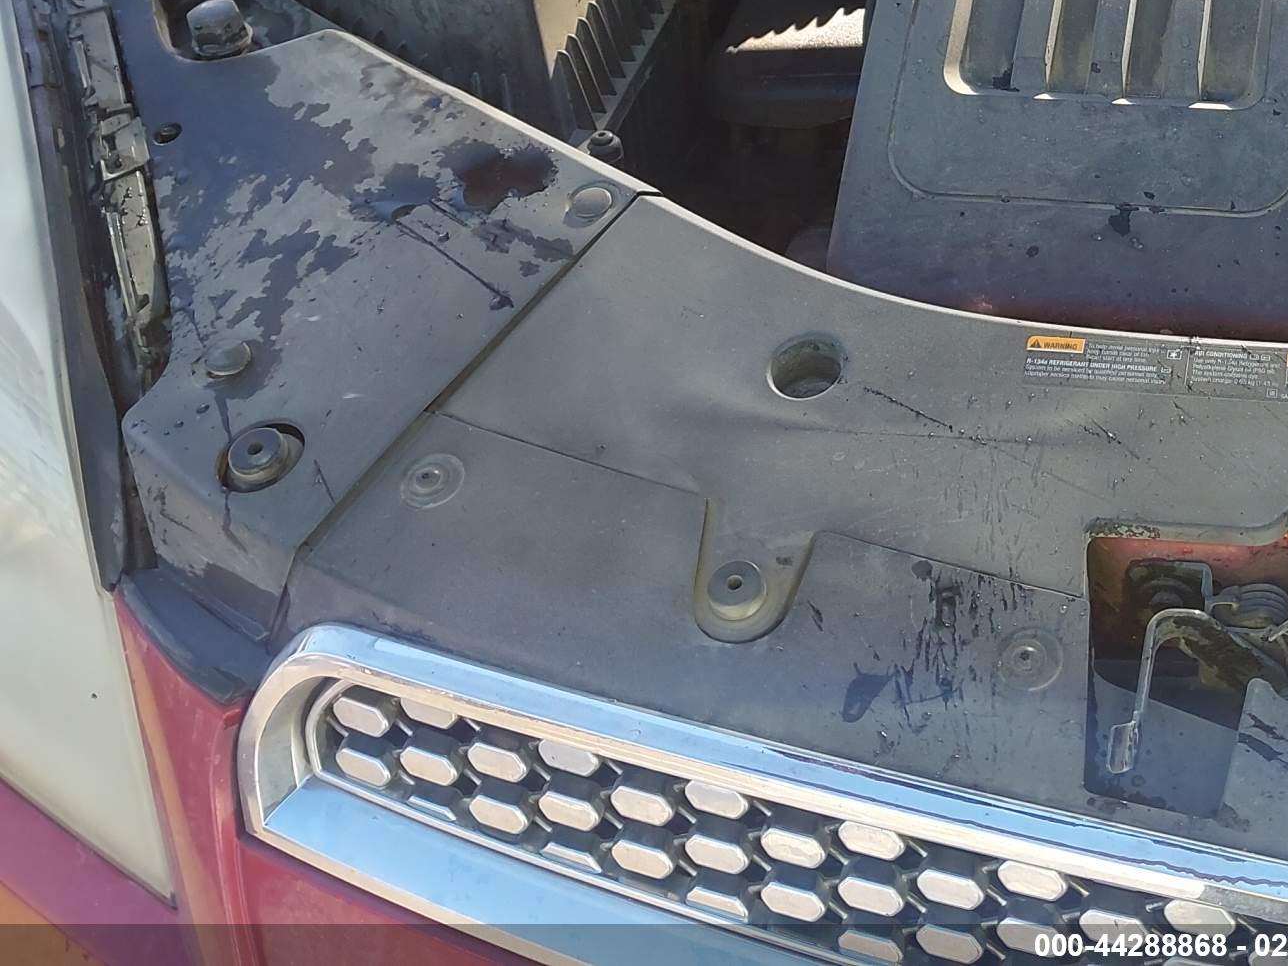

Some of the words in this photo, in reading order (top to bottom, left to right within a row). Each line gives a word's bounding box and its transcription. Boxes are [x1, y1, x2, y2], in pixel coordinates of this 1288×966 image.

[1043, 341, 1078, 350] WARNING
[1206, 351, 1246, 359] CONDITIONING
[1048, 359, 1088, 367] REFRIGERANT
[1126, 364, 1156, 372] PRESSURE
